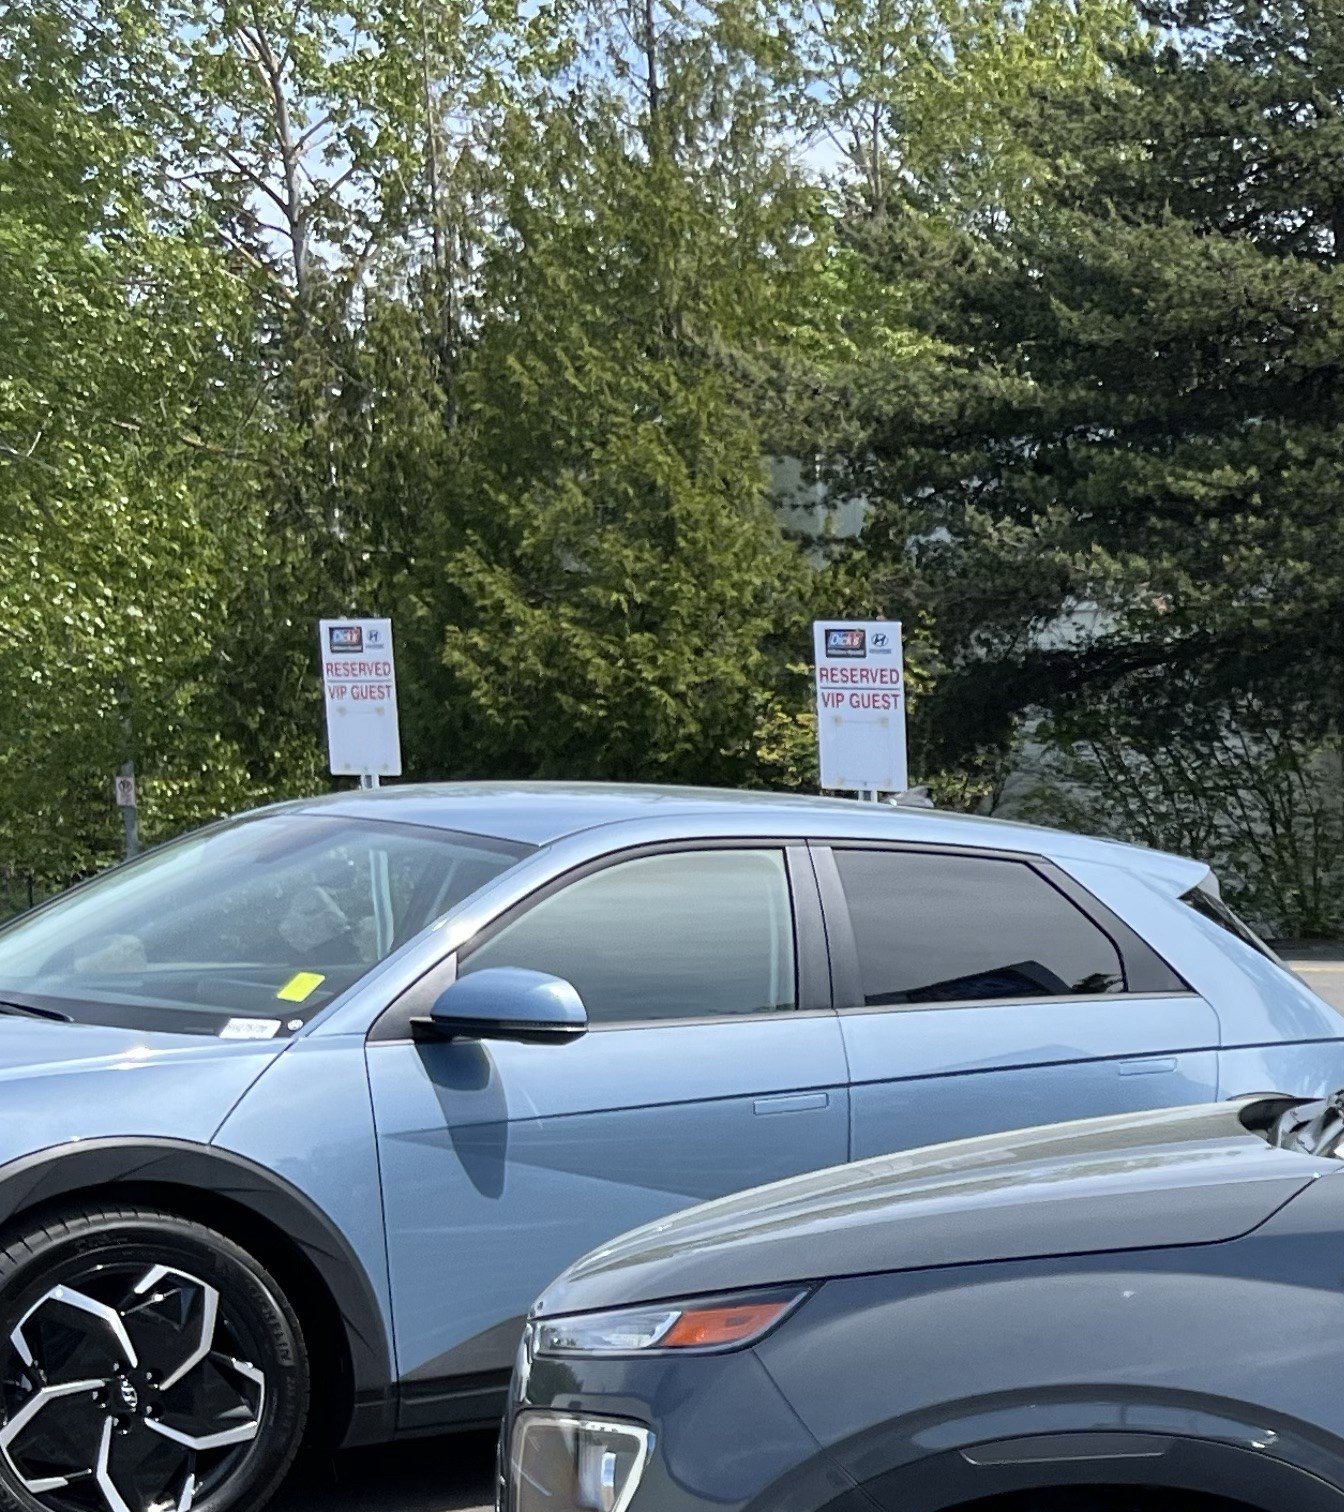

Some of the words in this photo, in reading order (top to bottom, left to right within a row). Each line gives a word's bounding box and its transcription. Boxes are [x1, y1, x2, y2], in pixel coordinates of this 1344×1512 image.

[326, 662, 391, 678] RESERVED
[819, 667, 900, 685] RESERVED
[328, 685, 347, 700] VIP
[351, 685, 392, 700] GUEST
[821, 692, 845, 709] VIP
[849, 692, 900, 709] GUEST
